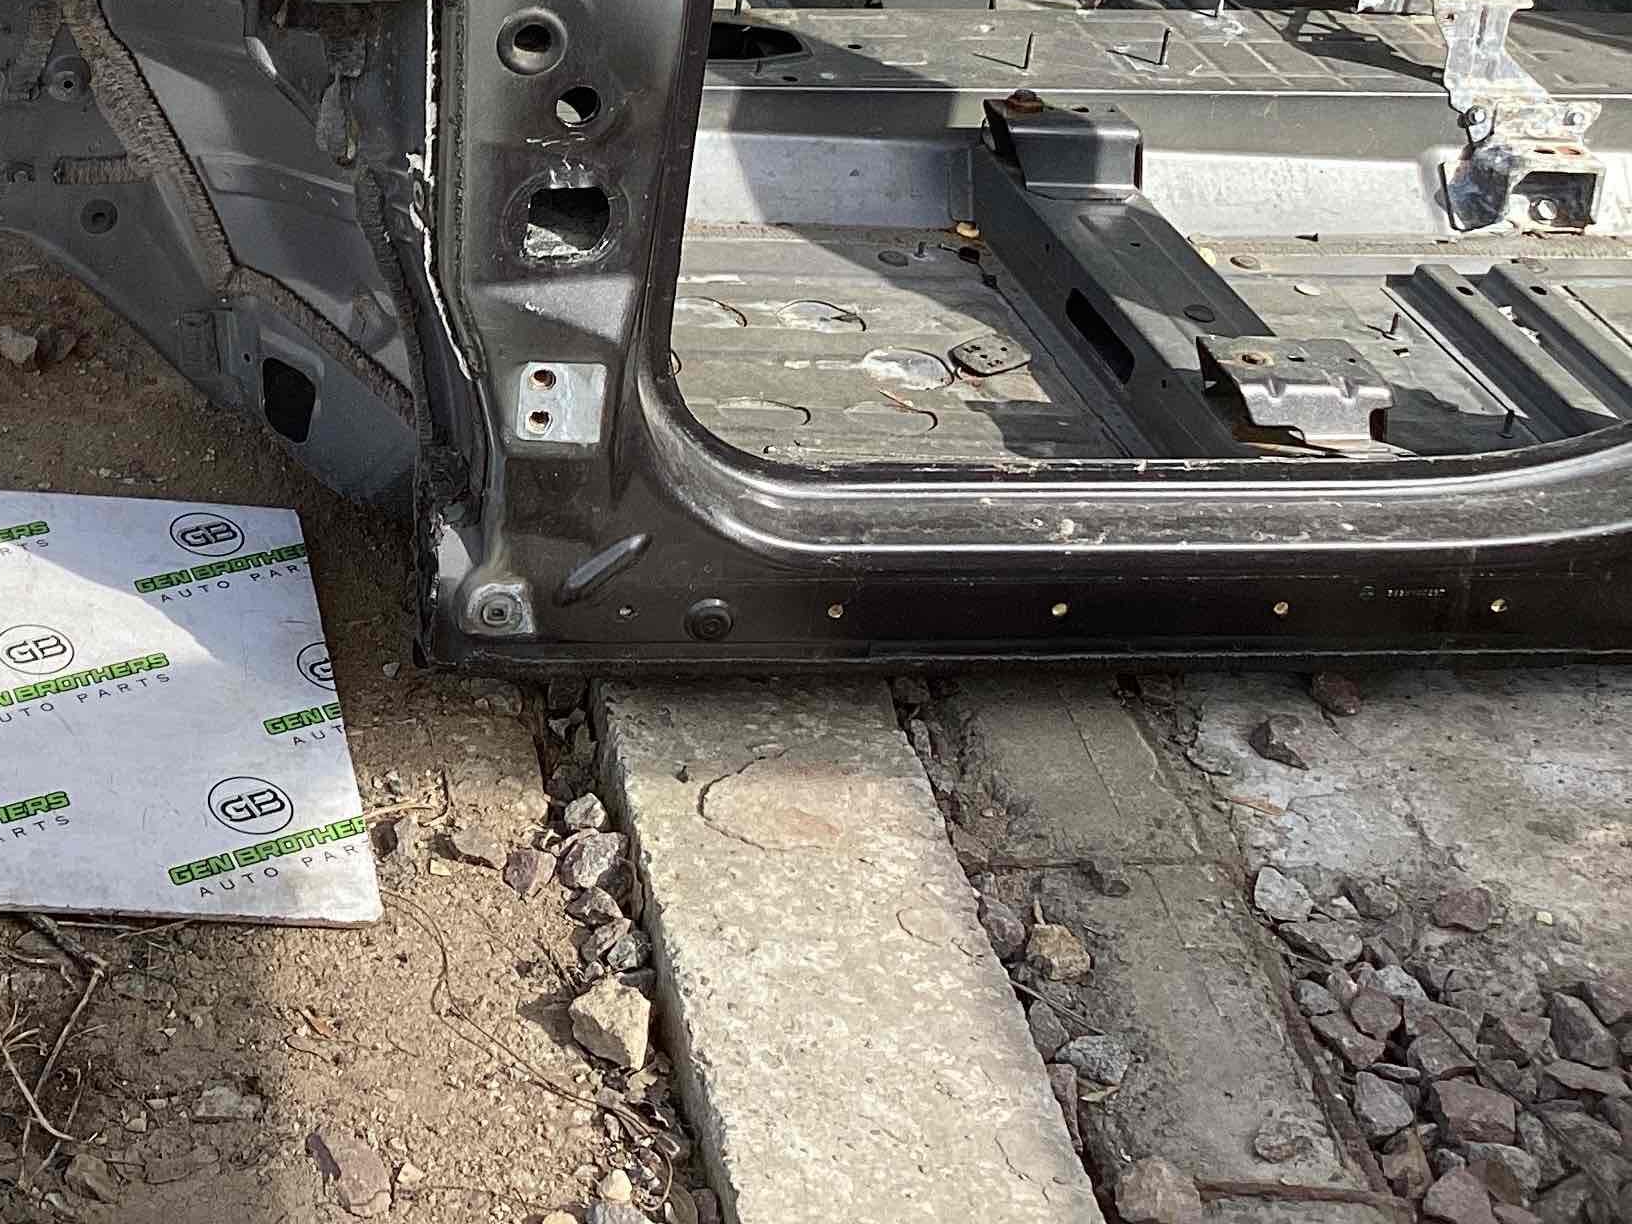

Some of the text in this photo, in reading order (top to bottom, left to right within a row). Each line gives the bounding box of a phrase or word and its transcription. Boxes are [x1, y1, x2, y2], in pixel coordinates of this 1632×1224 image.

[179, 522, 239, 547] GB
[134, 543, 305, 593] GEN BROTHER
[159, 561, 310, 603] AUTO PAR
[4, 634, 67, 664] GB
[15, 652, 170, 703] BROTHERS
[78, 673, 170, 703] PARTS
[263, 707, 325, 735] GEN
[293, 724, 343, 745] AUT
[220, 788, 286, 823] GB
[168, 815, 366, 887] GEN BROTHER
[200, 840, 368, 898] AUTO PAR
